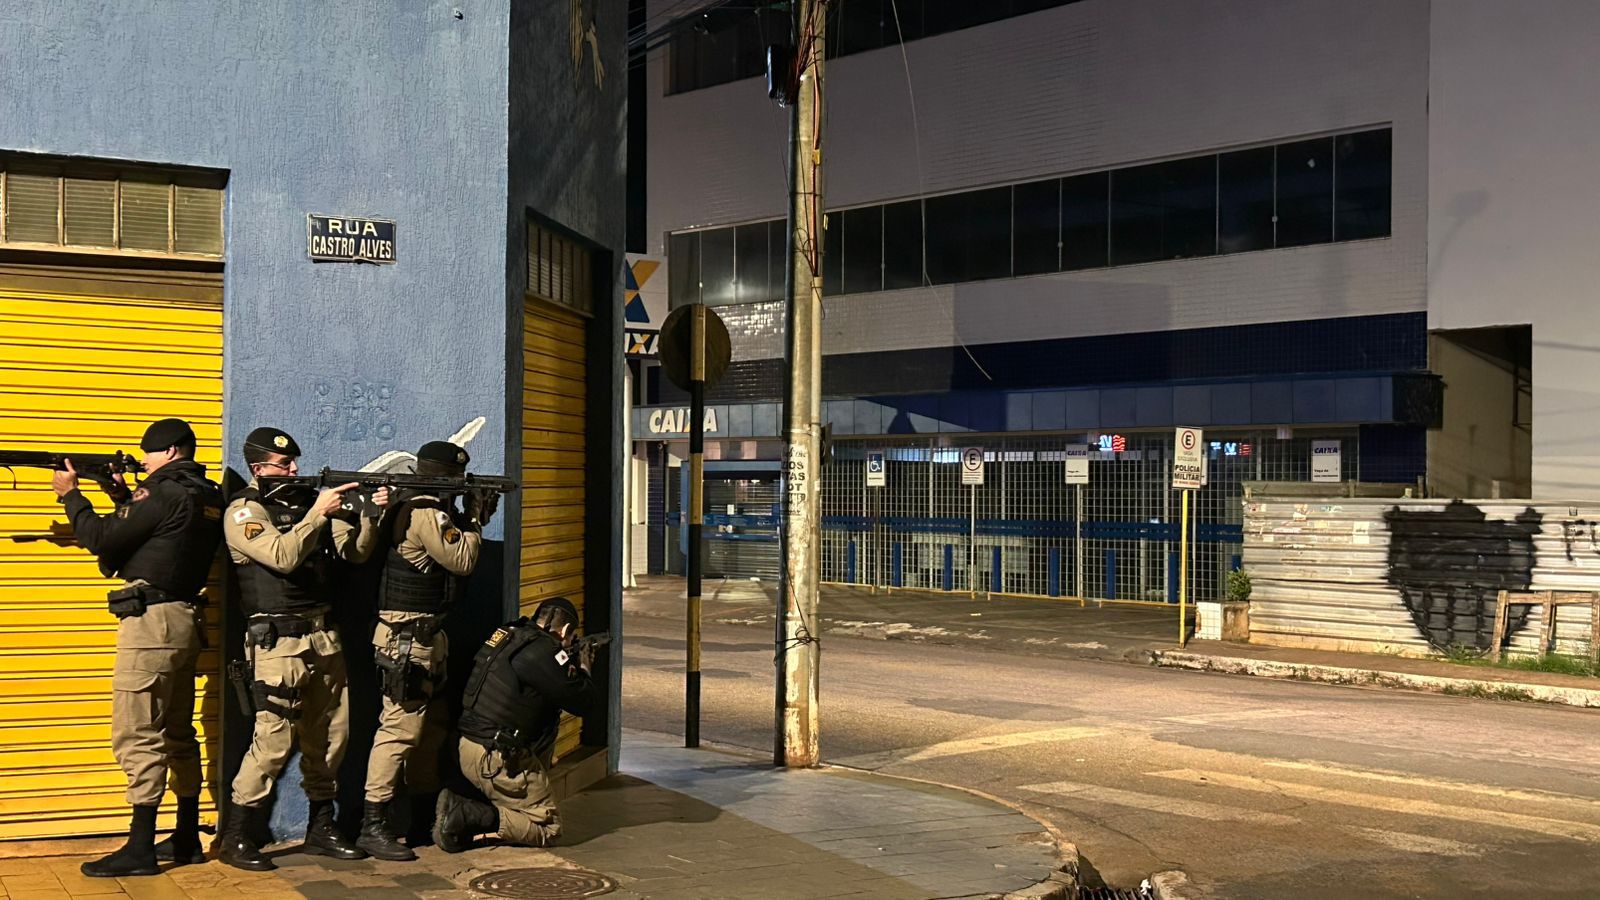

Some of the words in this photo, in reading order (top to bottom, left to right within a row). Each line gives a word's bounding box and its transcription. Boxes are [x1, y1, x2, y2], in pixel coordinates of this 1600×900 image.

[328, 219, 378, 237] RUA
[312, 235, 355, 256] CASTRO
[359, 238, 392, 259] ALVES
